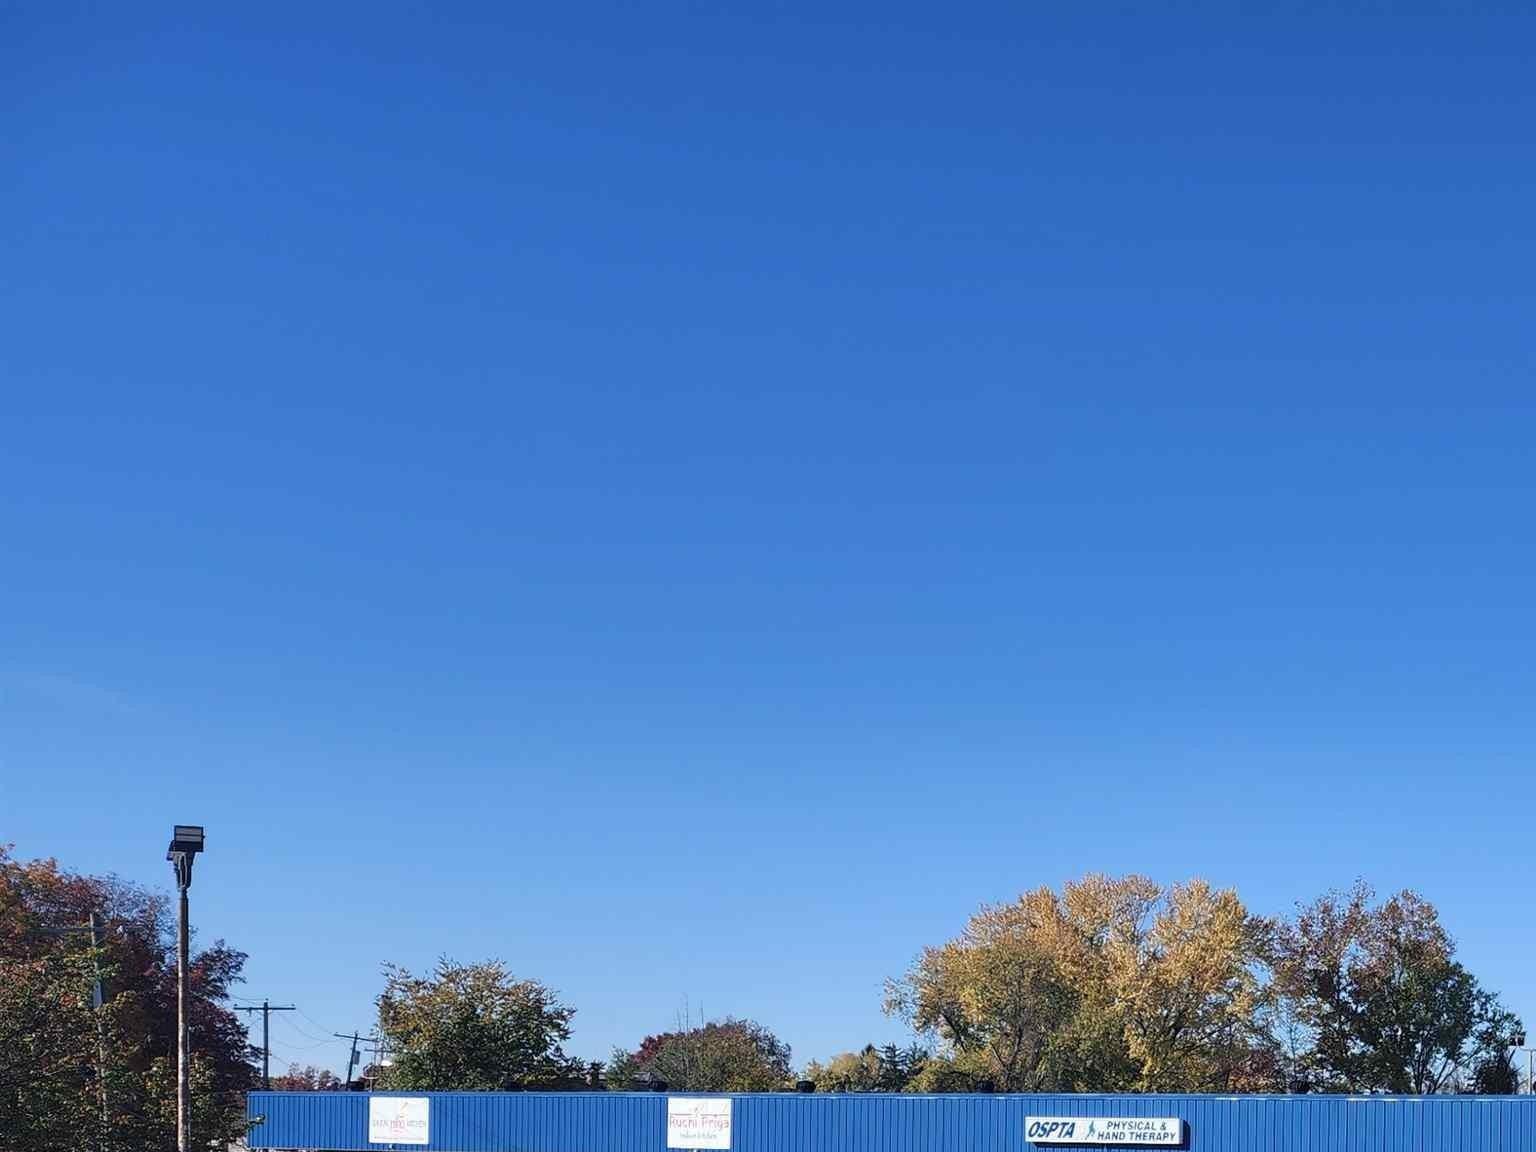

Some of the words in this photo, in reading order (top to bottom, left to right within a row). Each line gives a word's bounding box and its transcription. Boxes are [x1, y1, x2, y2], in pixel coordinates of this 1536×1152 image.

[1028, 1121, 1076, 1138] OSPTA
[1106, 1121, 1157, 1130] PHYSICAL
[1160, 1121, 1167, 1130] &
[1097, 1131, 1126, 1140] HAND
[1129, 1132, 1176, 1141] THERAPY
